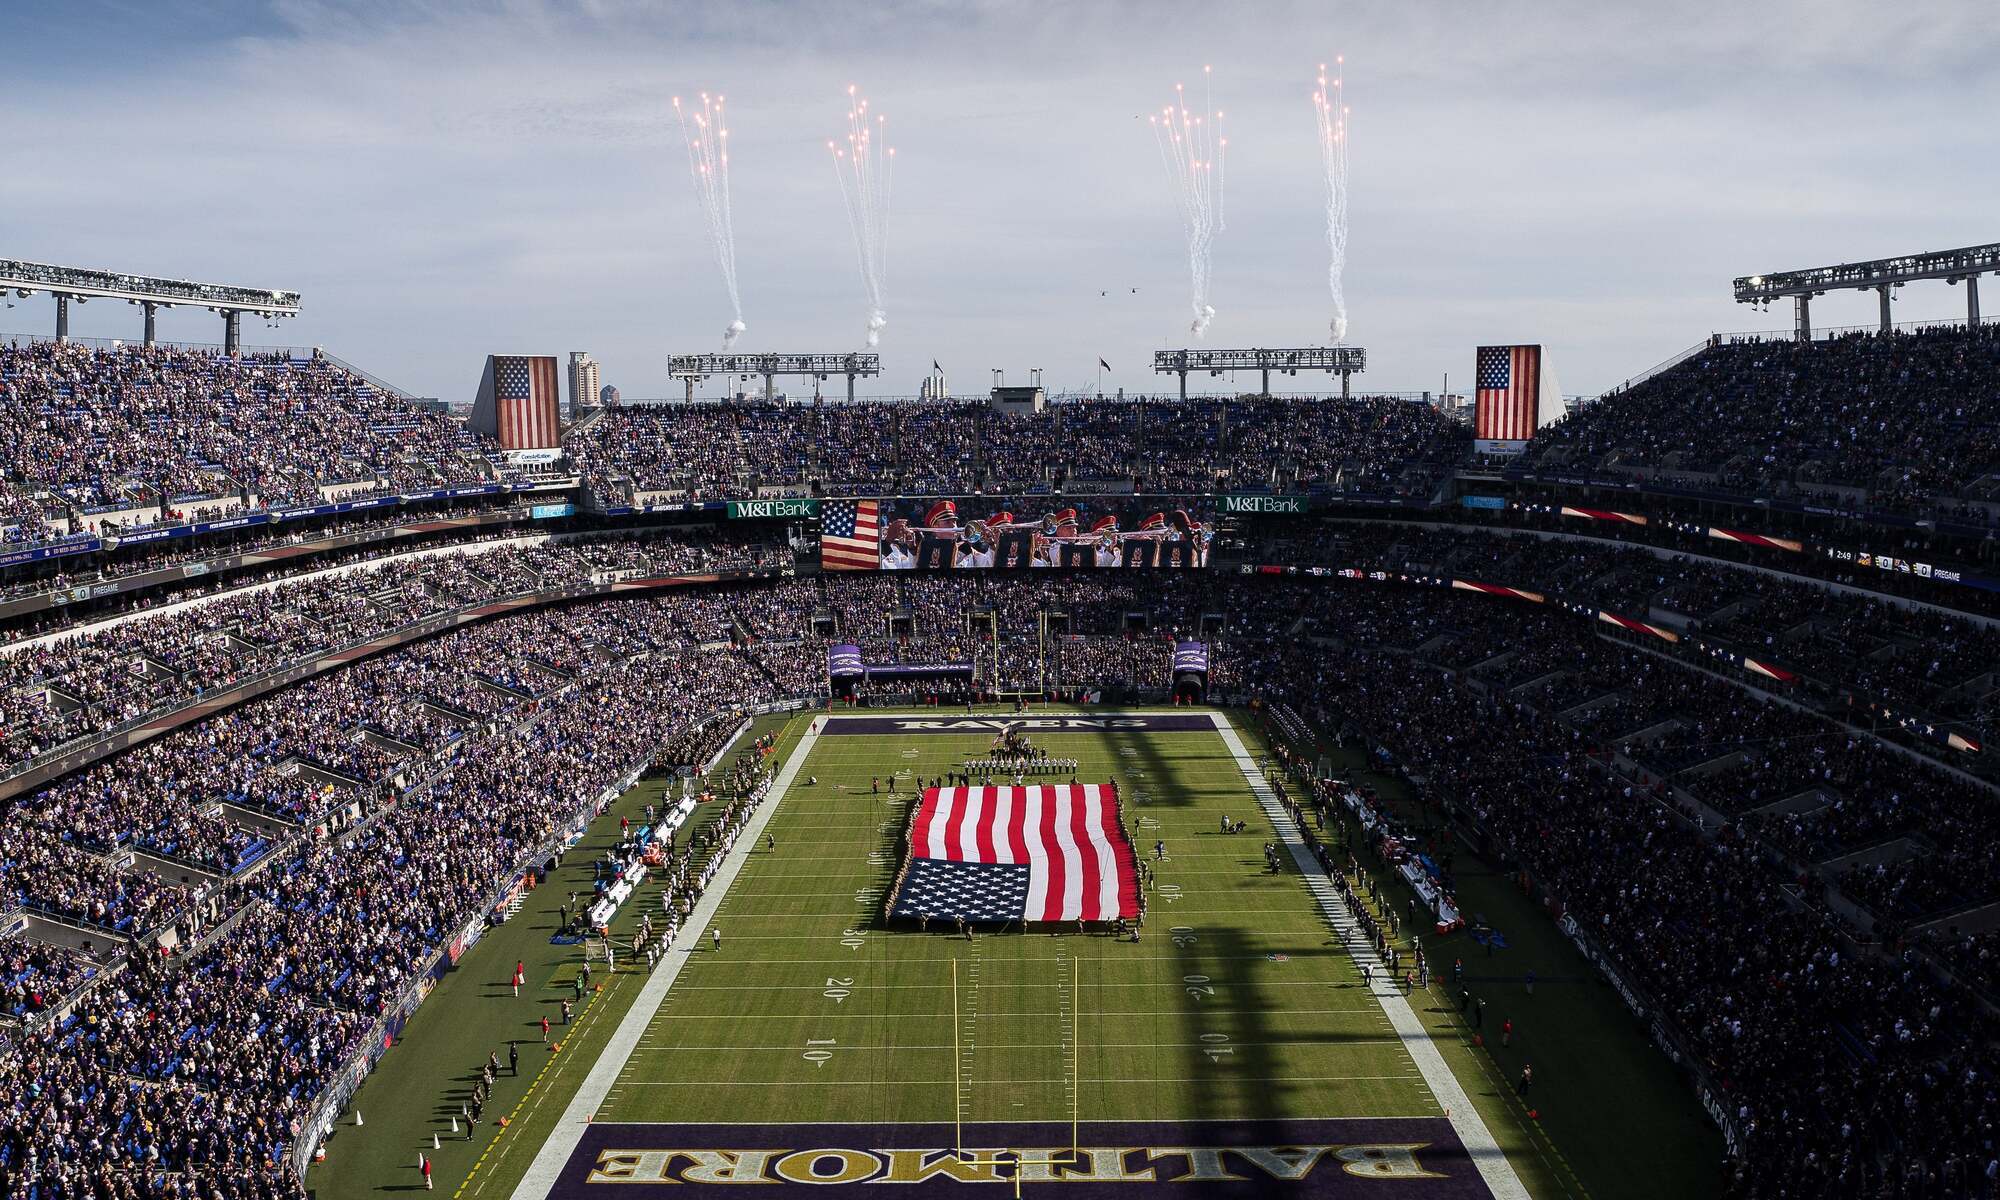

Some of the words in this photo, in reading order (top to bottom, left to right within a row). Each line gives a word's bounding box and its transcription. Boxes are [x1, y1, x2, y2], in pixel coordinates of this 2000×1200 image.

[737, 502, 774, 518] M&T
[776, 502, 811, 516] Bank
[1226, 497, 1263, 511] M&T
[1264, 497, 1299, 512] Bank
[1836, 550, 1851, 560] 2:49
[1882, 559, 1889, 568] 0
[1921, 566, 1927, 576] 0
[1934, 569, 1960, 581] PREGAME
[80, 589, 86, 599] 0
[93, 583, 119, 595] PREGAME
[894, 719, 1148, 730] RAVENS
[841, 928, 869, 946] 30
[1169, 927, 1197, 943] 30
[823, 977, 854, 998] 20
[1184, 975, 1215, 995] 20
[803, 1038, 836, 1061] 10
[1200, 1034, 1233, 1054] 10
[586, 1144, 1448, 1184] BALTIMORE
